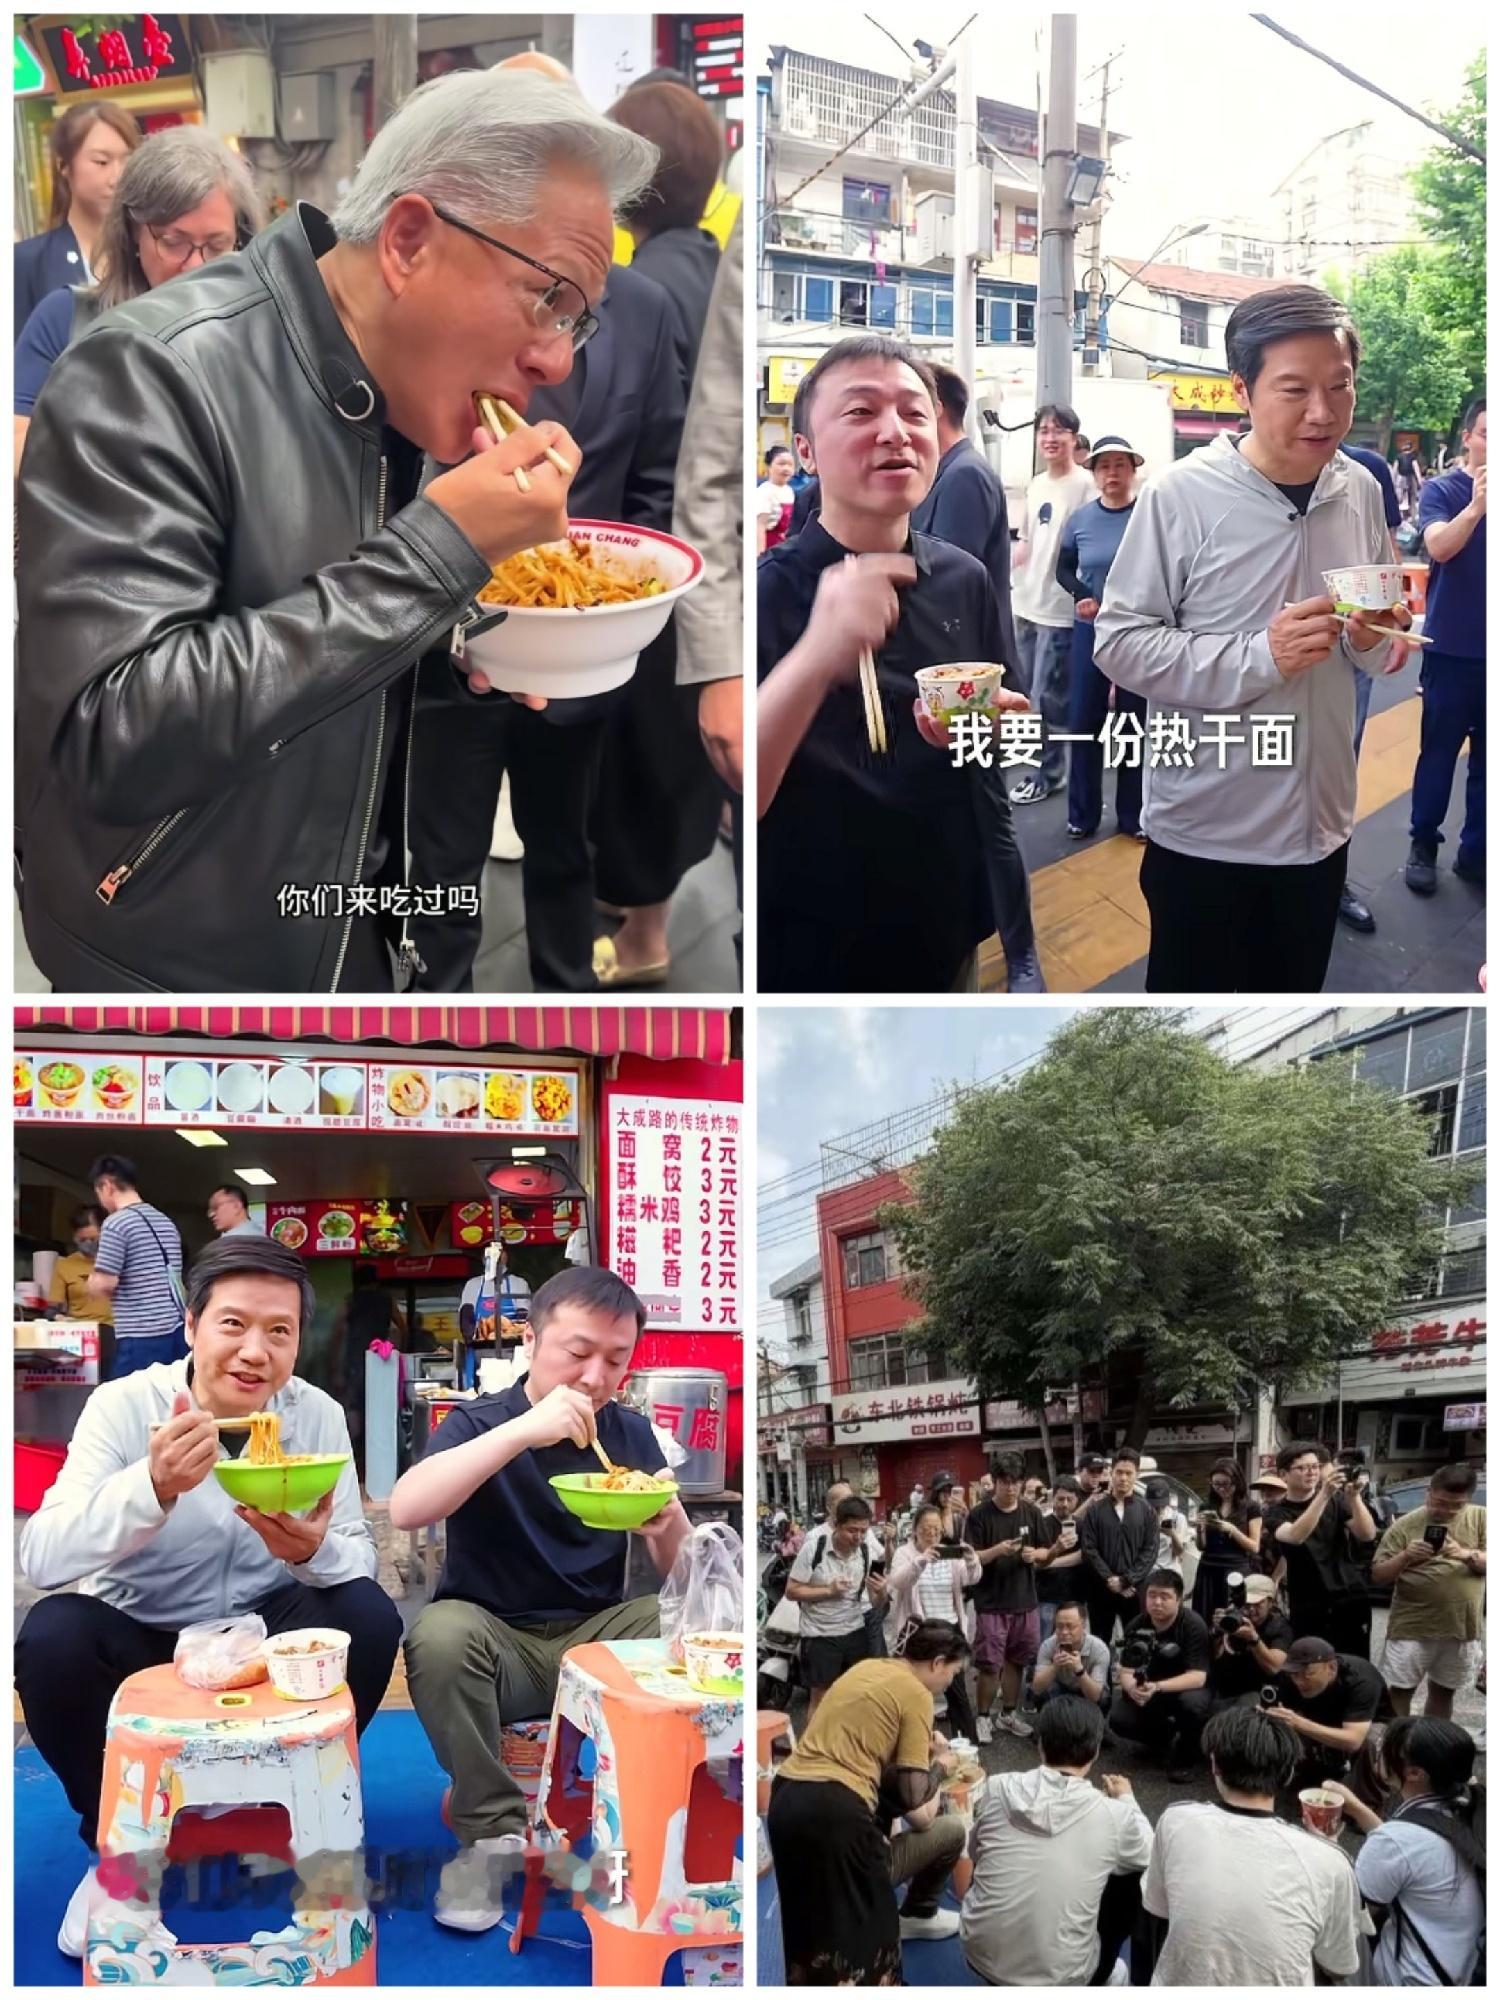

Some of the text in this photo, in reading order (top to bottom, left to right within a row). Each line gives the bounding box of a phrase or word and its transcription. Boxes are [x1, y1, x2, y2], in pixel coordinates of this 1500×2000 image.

[596, 533, 640, 548] CHANG
[148, 1073, 161, 1111] 饮品
[371, 1067, 385, 1128] 炸物小吃
[616, 1107, 740, 1134] 大成路的传统炸物
[617, 1194, 680, 1224] 糯米鸡
